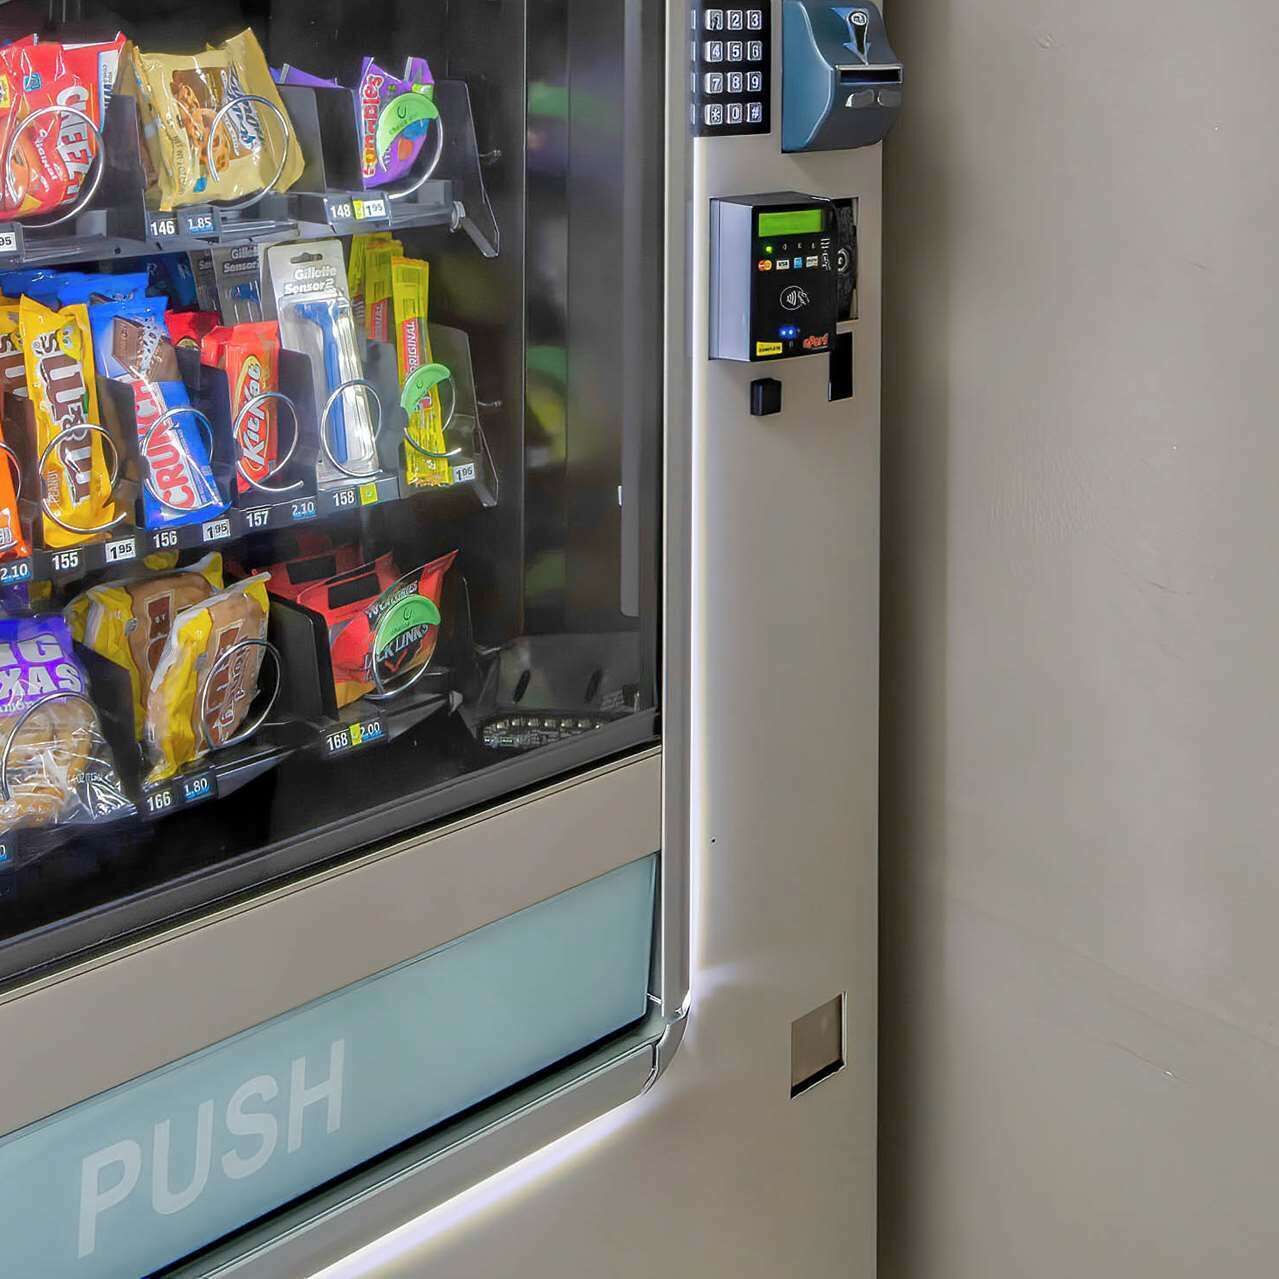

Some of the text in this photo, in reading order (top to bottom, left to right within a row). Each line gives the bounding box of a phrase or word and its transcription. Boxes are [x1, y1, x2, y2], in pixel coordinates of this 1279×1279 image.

[330, 205, 351, 218] 148
[150, 221, 175, 236] 146
[188, 217, 213, 229] 1.85
[223, 261, 260, 273] Sensor
[333, 490, 355, 506] 158
[292, 501, 315, 515] 2.10
[246, 511, 269, 527] 157
[153, 532, 178, 548] 156
[52, 553, 79, 570] 155
[0, 564, 29, 580] 2.10
[327, 732, 348, 751] 168
[183, 777, 208, 797] 1.80
[147, 791, 171, 811] 166
[78, 1039, 345, 1260] PUSH
